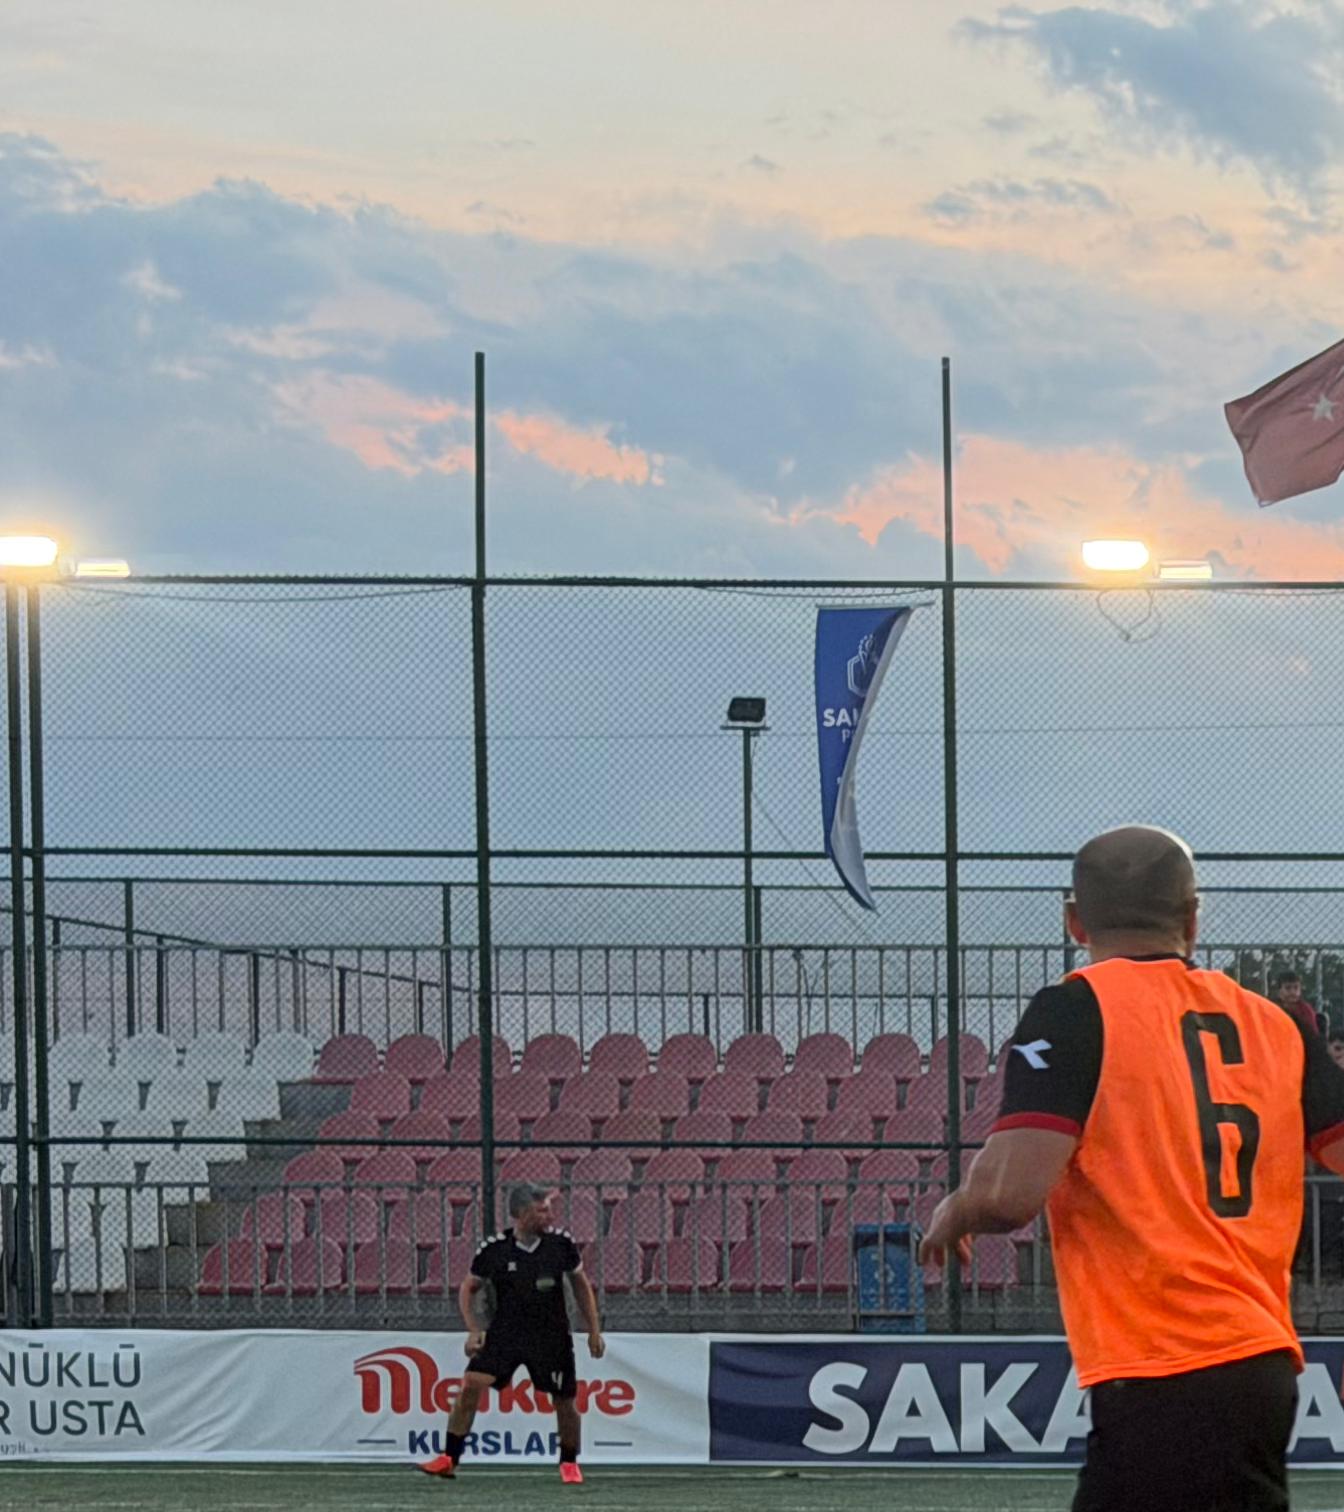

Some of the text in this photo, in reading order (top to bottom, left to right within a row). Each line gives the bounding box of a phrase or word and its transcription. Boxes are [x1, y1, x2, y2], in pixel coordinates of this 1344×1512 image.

[1182, 1010, 1260, 1218] 6
[353, 1346, 636, 1415] Mekre
[552, 1371, 563, 1390] 4
[30, 1400, 146, 1436] USTA
[408, 1430, 581, 1455] KURSLA
